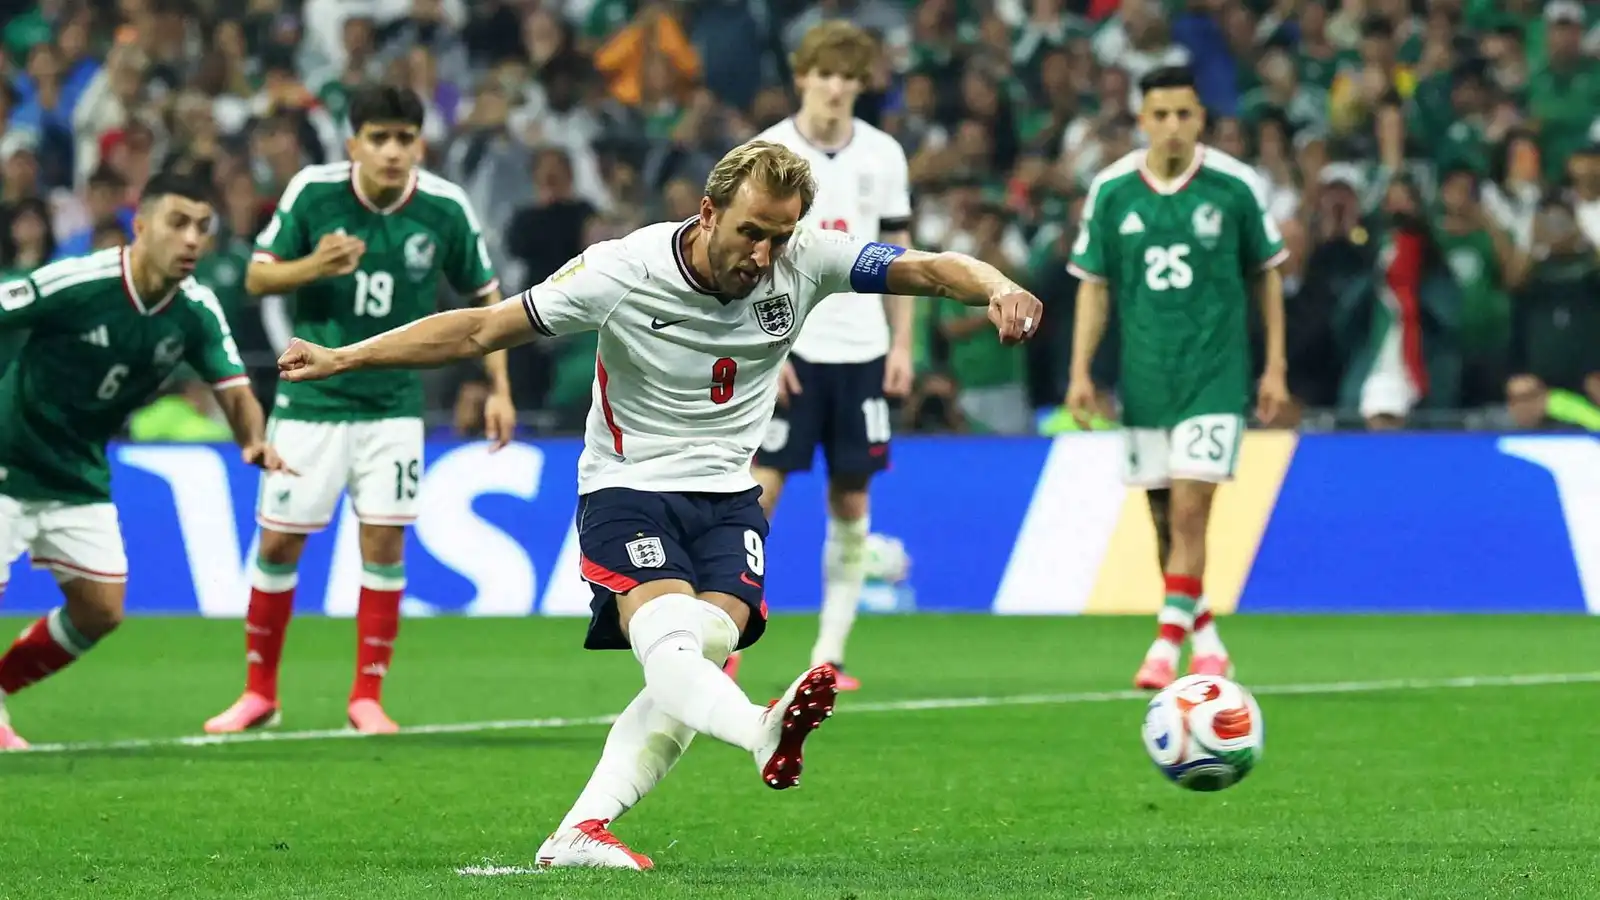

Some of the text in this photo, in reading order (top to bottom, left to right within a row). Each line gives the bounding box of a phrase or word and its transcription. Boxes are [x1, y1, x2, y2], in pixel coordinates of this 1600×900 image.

[855, 245, 878, 271] FOOTBALL
[862, 246, 886, 273] UNITES
[1145, 243, 1193, 291] 25
[354, 270, 393, 317] 19
[97, 364, 129, 400] 6
[711, 356, 737, 405] 9
[1187, 423, 1225, 461] 25
[394, 460, 418, 500] 19
[115, 438, 592, 616] VS
[743, 529, 764, 576] 9
